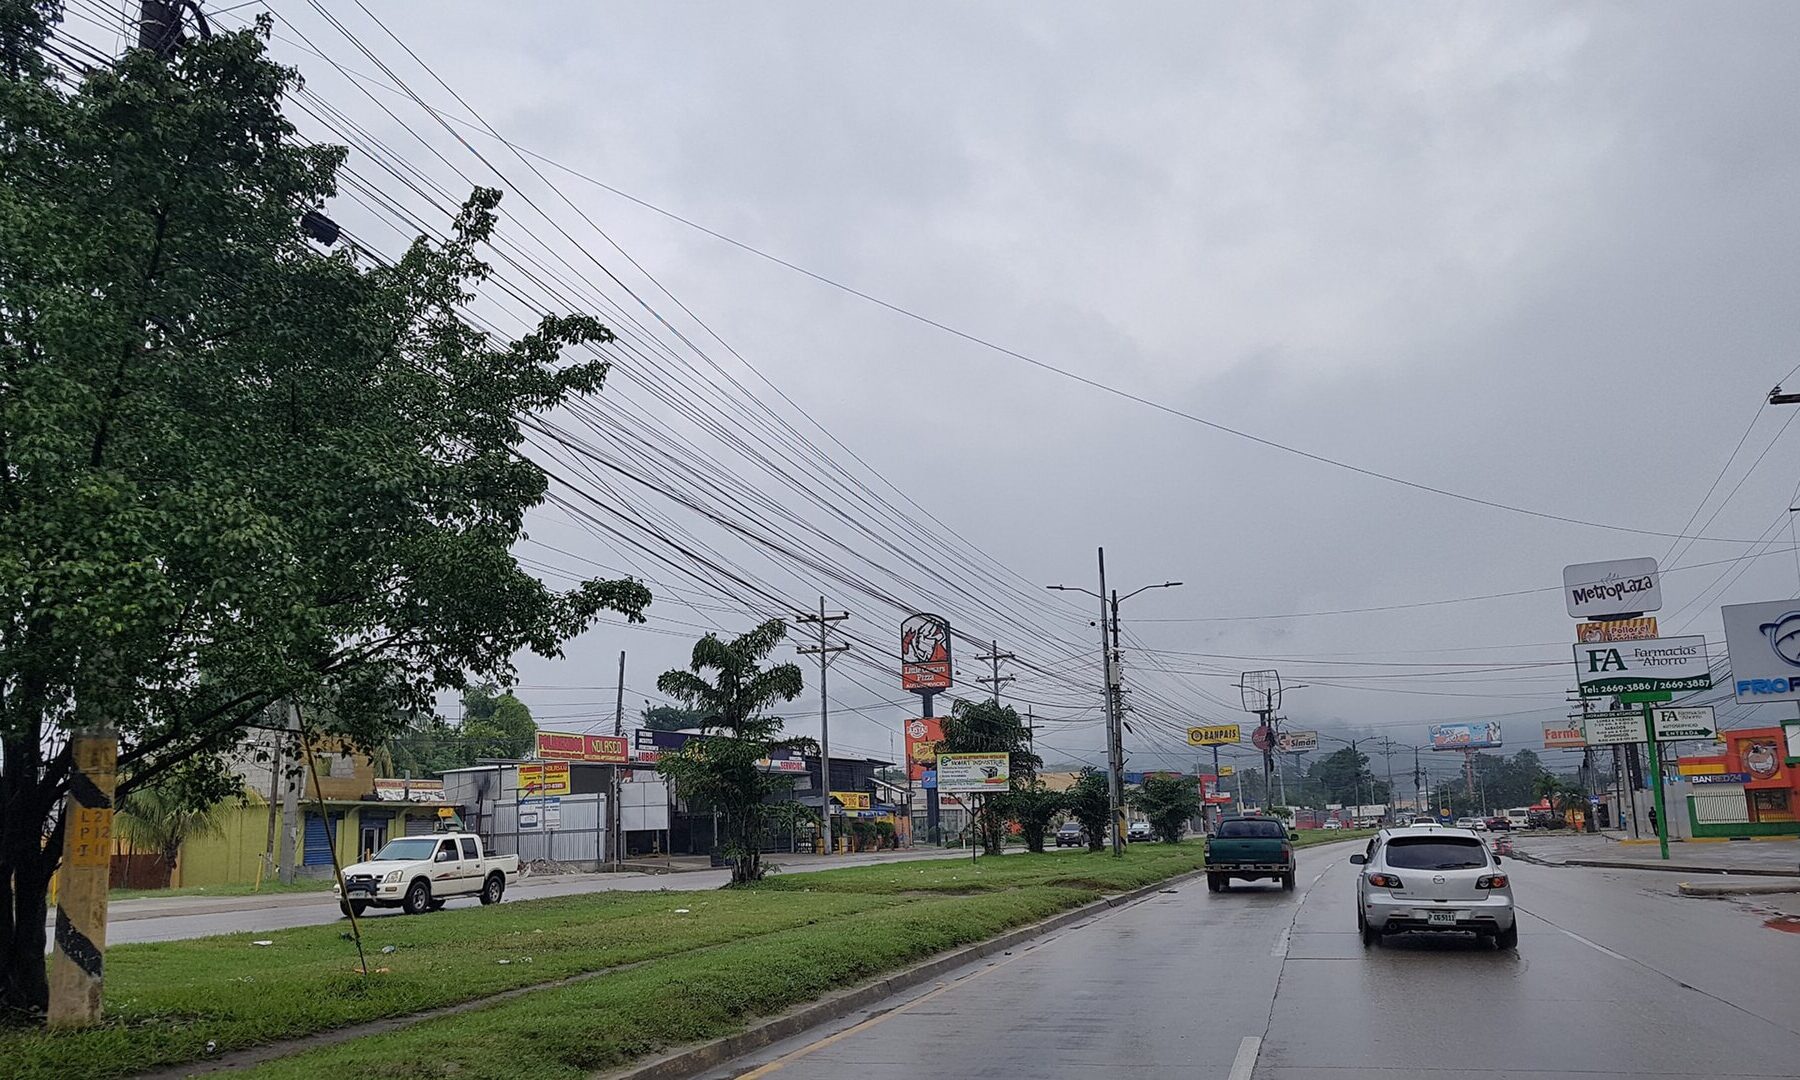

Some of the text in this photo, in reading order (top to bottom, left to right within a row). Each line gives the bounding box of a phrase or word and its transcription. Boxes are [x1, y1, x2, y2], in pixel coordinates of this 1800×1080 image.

[1634, 646, 1697, 658] Farmacias
[1585, 648, 1628, 672] FA
[1643, 656, 1687, 666] Ahorro
[1582, 685, 1599, 694] Tel:
[1600, 682, 1651, 693] 2669-3886
[1660, 679, 1710, 689] 2669-3887
[1660, 711, 1679, 721] FA
[592, 739, 622, 754] NOLASCO
